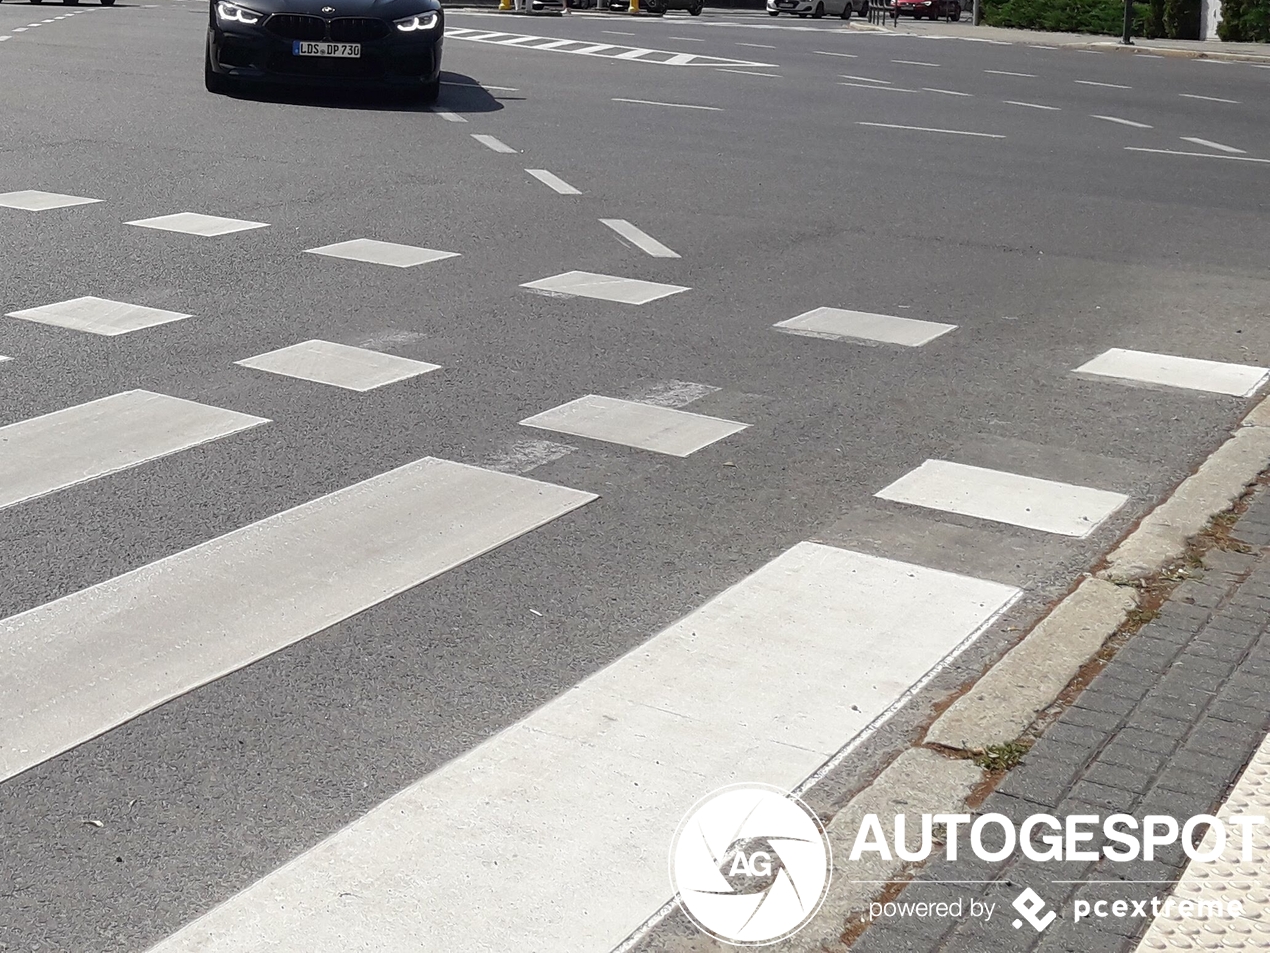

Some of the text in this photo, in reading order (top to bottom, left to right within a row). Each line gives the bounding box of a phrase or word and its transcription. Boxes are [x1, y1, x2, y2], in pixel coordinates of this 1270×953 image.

[300, 43, 359, 56] LDS DP 730
